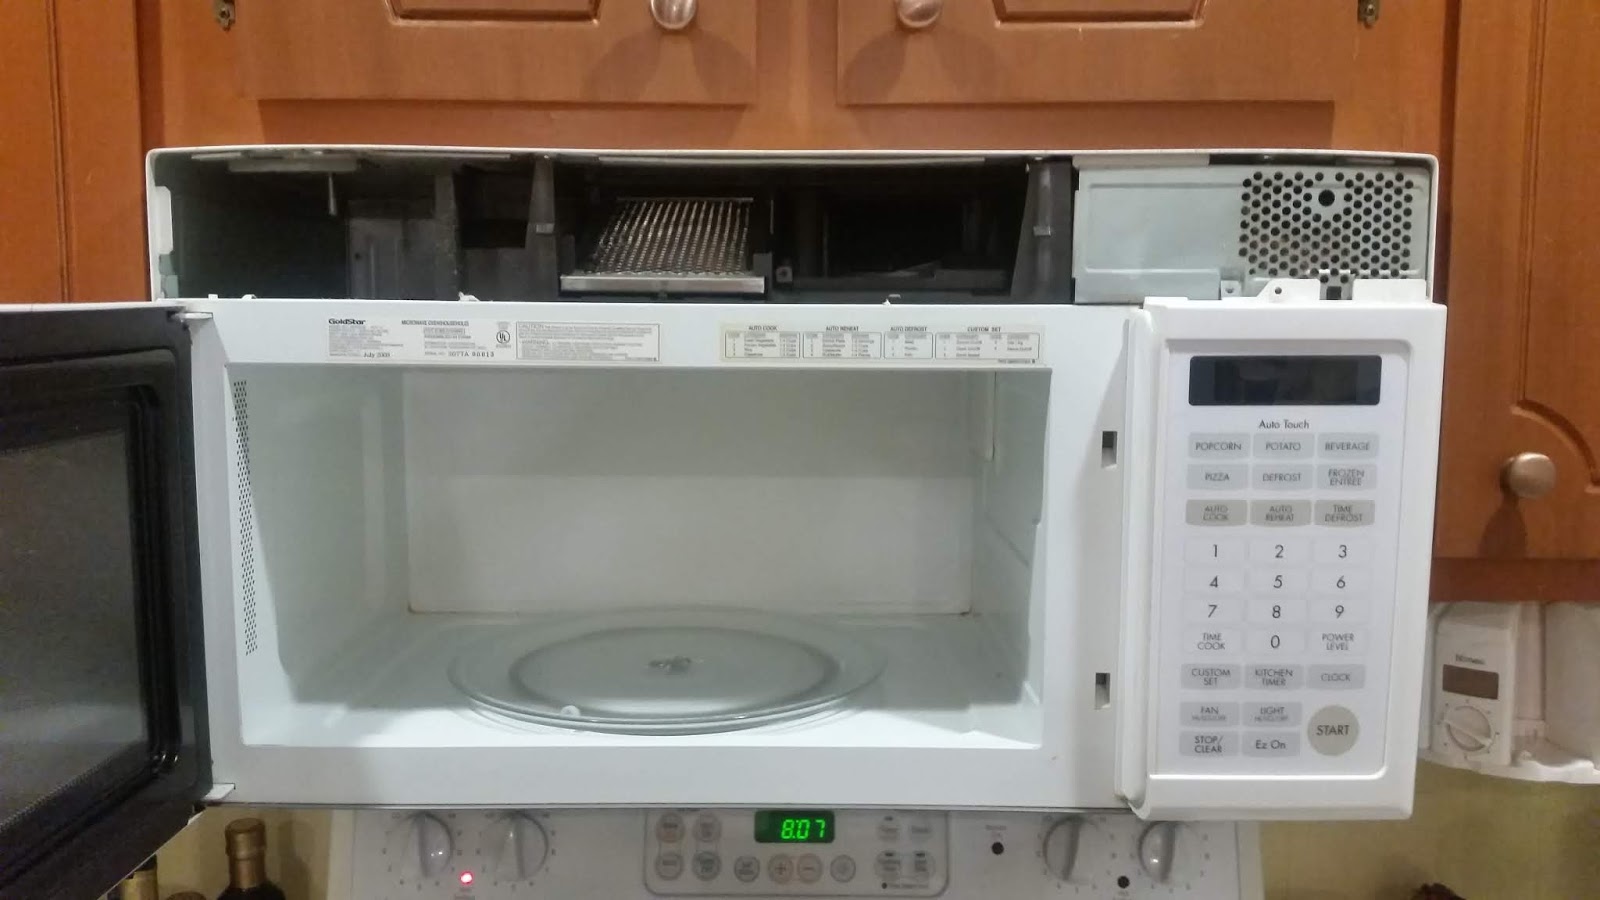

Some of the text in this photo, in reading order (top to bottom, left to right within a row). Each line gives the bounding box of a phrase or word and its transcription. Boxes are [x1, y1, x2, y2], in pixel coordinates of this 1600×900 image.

[363, 351, 375, 359] July
[1258, 419, 1310, 430] Auto Touch
[1195, 442, 1242, 451] POPCORN
[1265, 442, 1301, 451] POTATO
[1324, 442, 1370, 451] BEVERAGE
[1204, 472, 1230, 482] PIZZA
[1262, 473, 1302, 482] DEFROST
[1328, 469, 1364, 478] FROZEN
[1204, 505, 1228, 513] AUTO
[1269, 505, 1293, 513] AUTO
[1333, 505, 1353, 513] TIME
[1202, 513, 1229, 522] COOK
[1265, 513, 1294, 522] REHEAT
[1324, 513, 1363, 522] DEFROST
[1212, 544, 1218, 558] 1
[1274, 544, 1285, 559] 2
[1337, 544, 1348, 559] 3
[1209, 575, 1219, 588] 4
[1273, 575, 1283, 589] 5
[1336, 575, 1346, 589] 6
[1207, 604, 1218, 618] 7
[1271, 604, 1281, 619] 8
[1334, 604, 1345, 619] 9
[1202, 633, 1222, 641] TIME
[1270, 634, 1281, 649] 0
[1321, 633, 1355, 642] POWER
[1197, 641, 1226, 651] COOK
[1326, 641, 1349, 651] LEVEL
[1191, 668, 1231, 677] CUSTOM
[1254, 668, 1293, 677] KITCHEN
[1320, 672, 1351, 682] CLOCK
[1203, 677, 1218, 686] SET
[1262, 678, 1287, 686] TIMER
[1200, 706, 1219, 714] FAN
[1260, 706, 1285, 714] LIGHT
[1316, 725, 1350, 736] START
[1194, 735, 1224, 744] STOP/
[1194, 744, 1223, 754] CLEAR
[1255, 740, 1286, 749] Ez On
